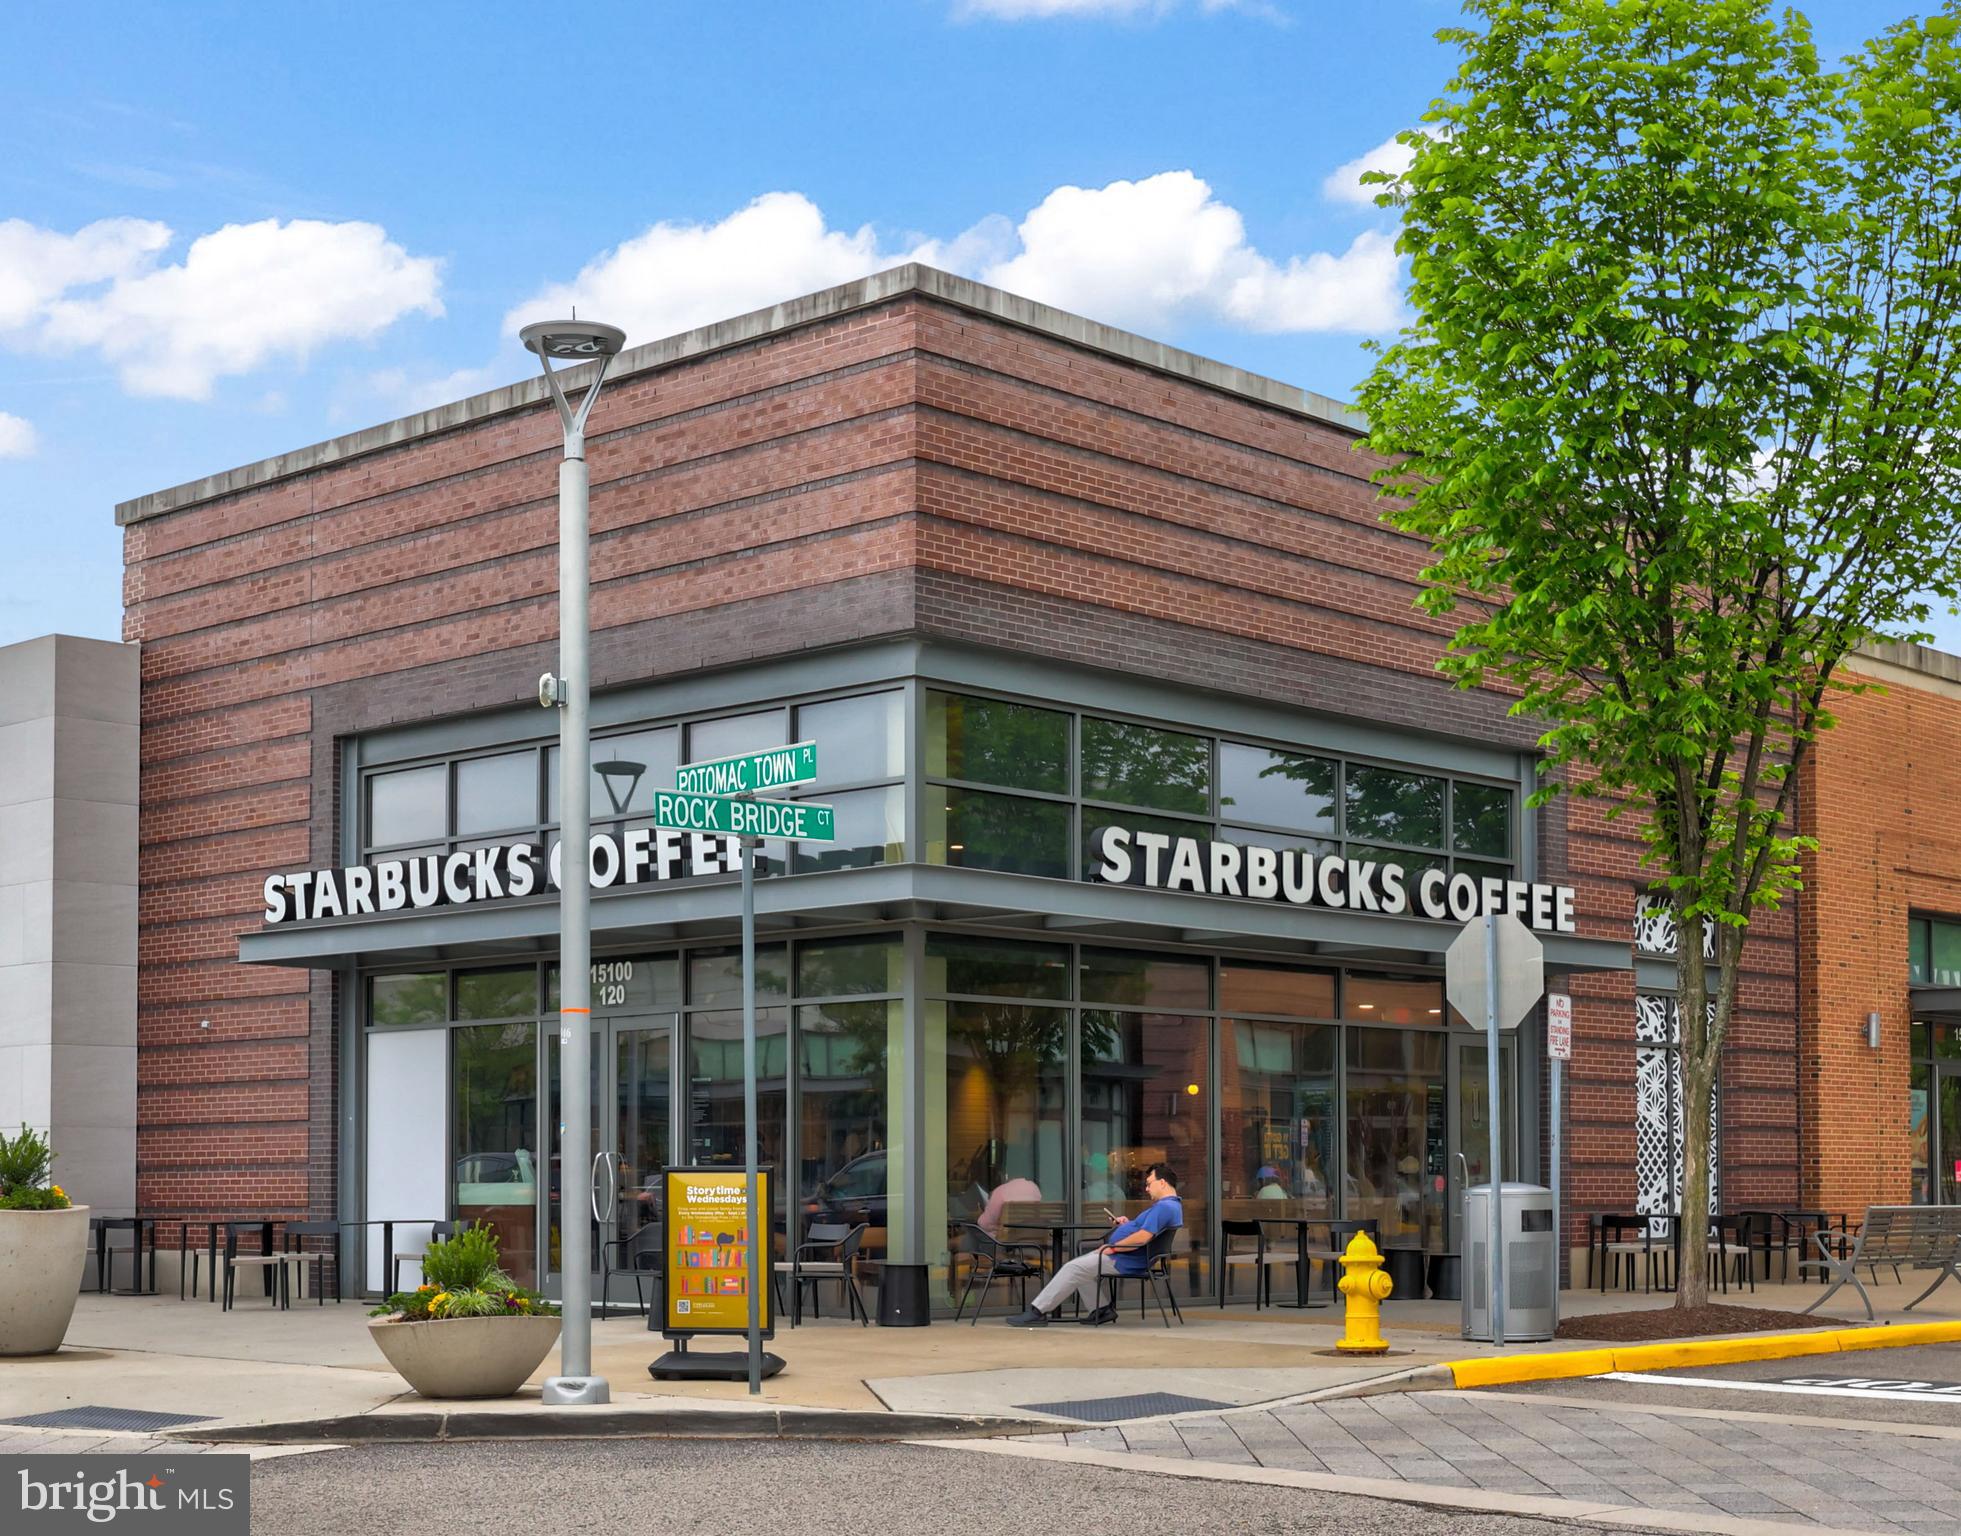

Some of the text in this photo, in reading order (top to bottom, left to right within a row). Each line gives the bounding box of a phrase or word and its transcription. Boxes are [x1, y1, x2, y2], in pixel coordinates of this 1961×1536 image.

[678, 748, 814, 795] POTOMAC TOWN PL
[658, 794, 830, 837] ROCK BRIDGE CT
[263, 843, 535, 923] STARBUCKS
[1100, 826, 1576, 932] STARBUCKS COFFEE
[590, 961, 633, 983] 15100
[600, 985, 625, 1005] 120
[1556, 998, 1564, 1008] NO
[1551, 1009, 1569, 1019] PARKING
[1551, 1026, 1569, 1036] STANDING
[686, 1186, 741, 1196] Storytime
[686, 1195, 748, 1205] Wednesdays
